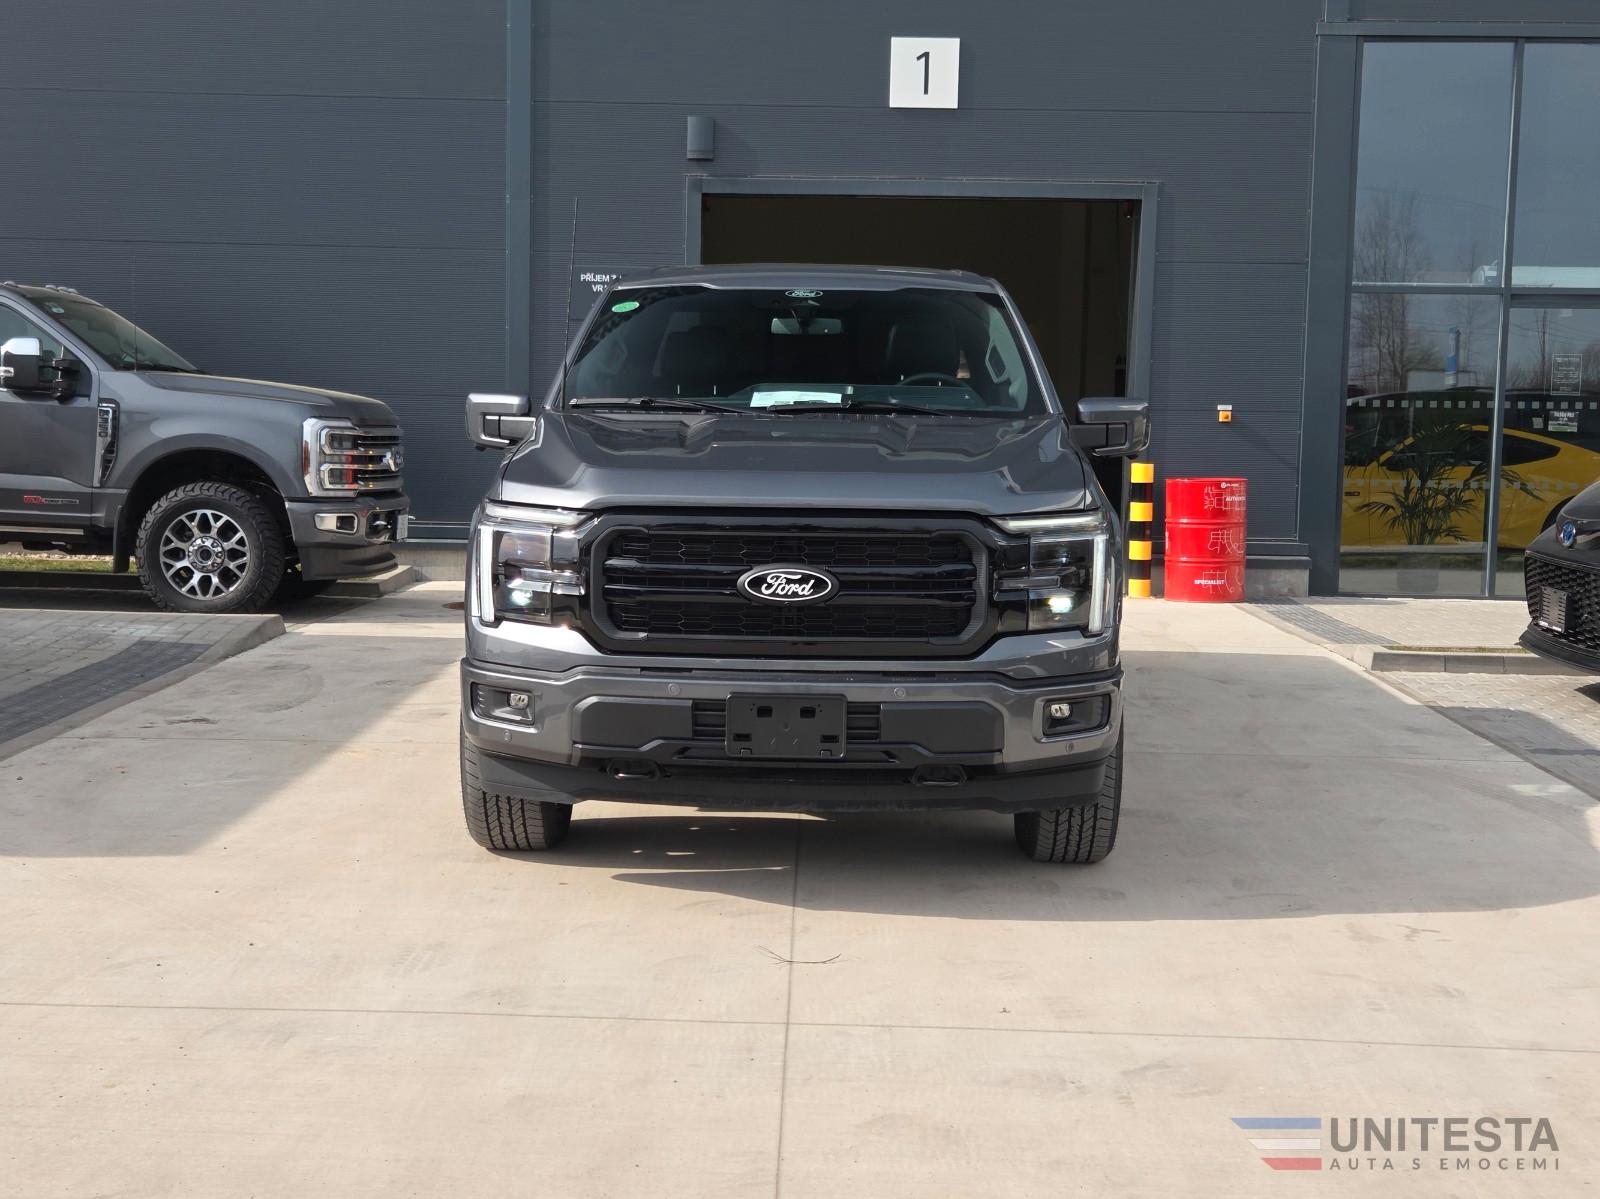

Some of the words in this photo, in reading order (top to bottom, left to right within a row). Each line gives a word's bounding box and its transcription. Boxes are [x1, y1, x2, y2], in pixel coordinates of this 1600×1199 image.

[916, 51, 930, 95] 1
[580, 273, 610, 282] PŘÍJEM
[761, 573, 815, 595] Ford
